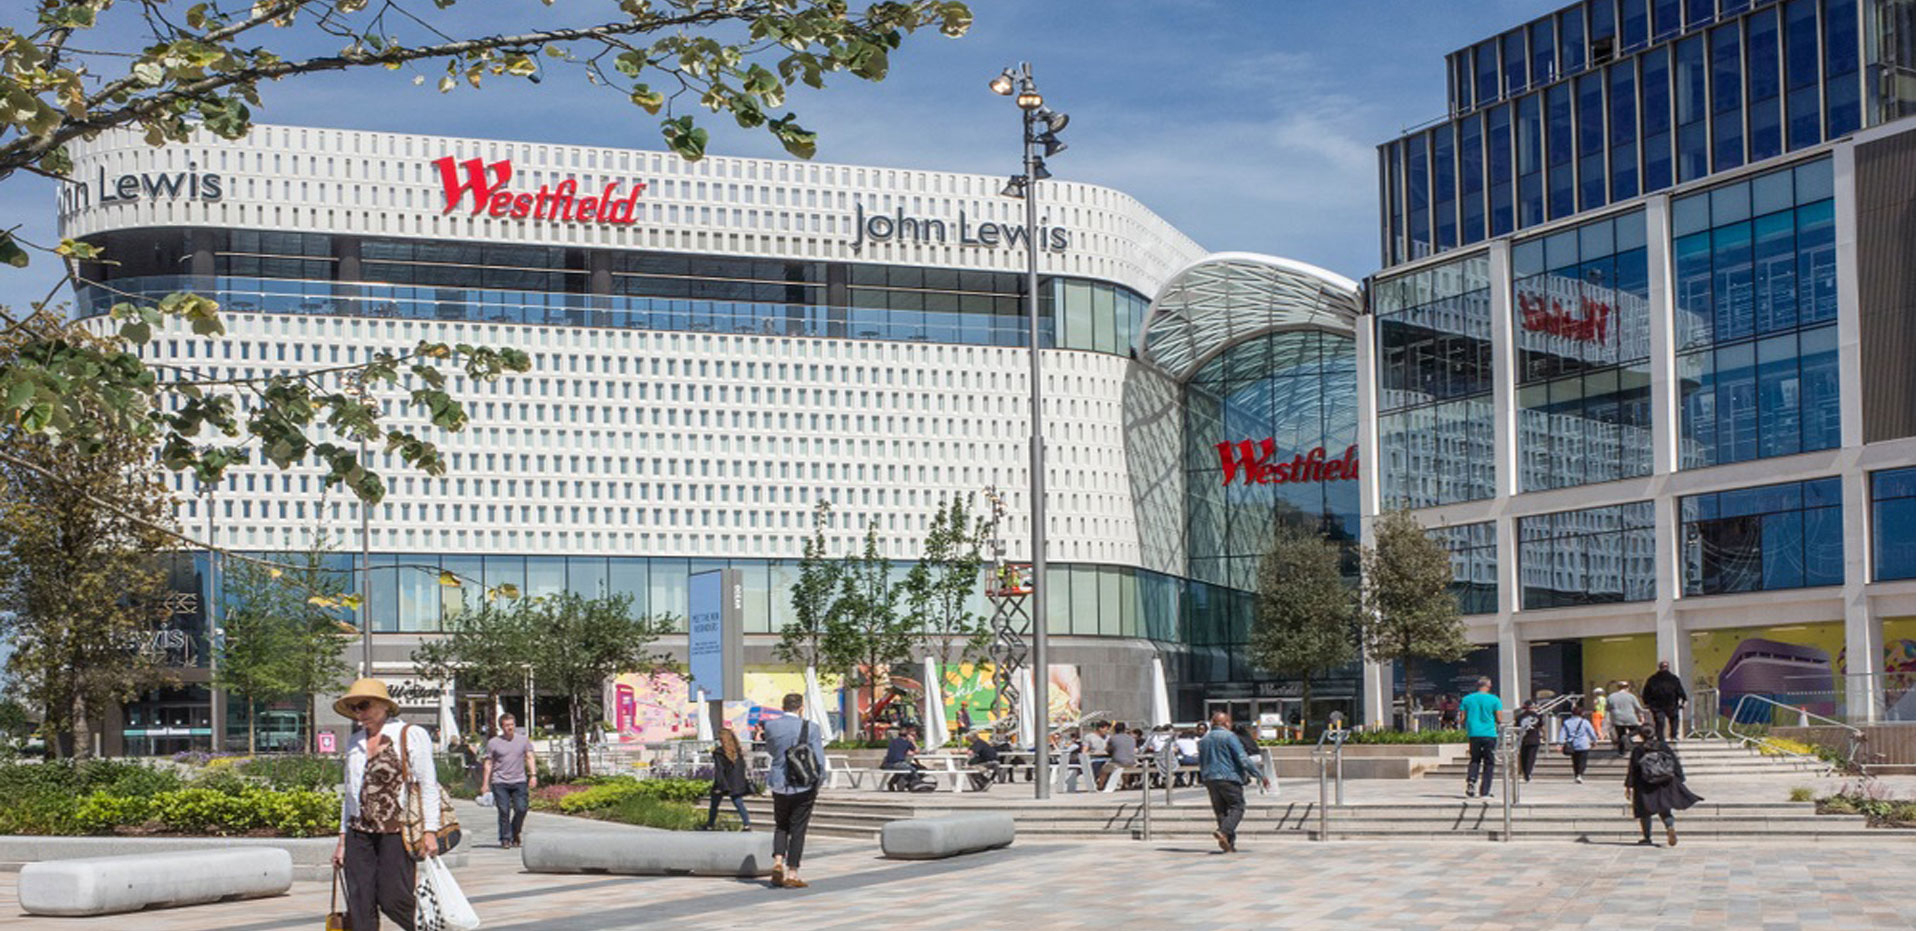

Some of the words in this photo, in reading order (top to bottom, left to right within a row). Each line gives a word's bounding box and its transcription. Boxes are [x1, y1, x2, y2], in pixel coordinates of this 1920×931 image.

[57, 179, 88, 216] ohn
[100, 161, 223, 203] Lewis
[431, 155, 647, 225] Westfield
[849, 203, 946, 256] John
[959, 209, 1069, 253] Lewis
[1214, 437, 1359, 486] Westfiel
